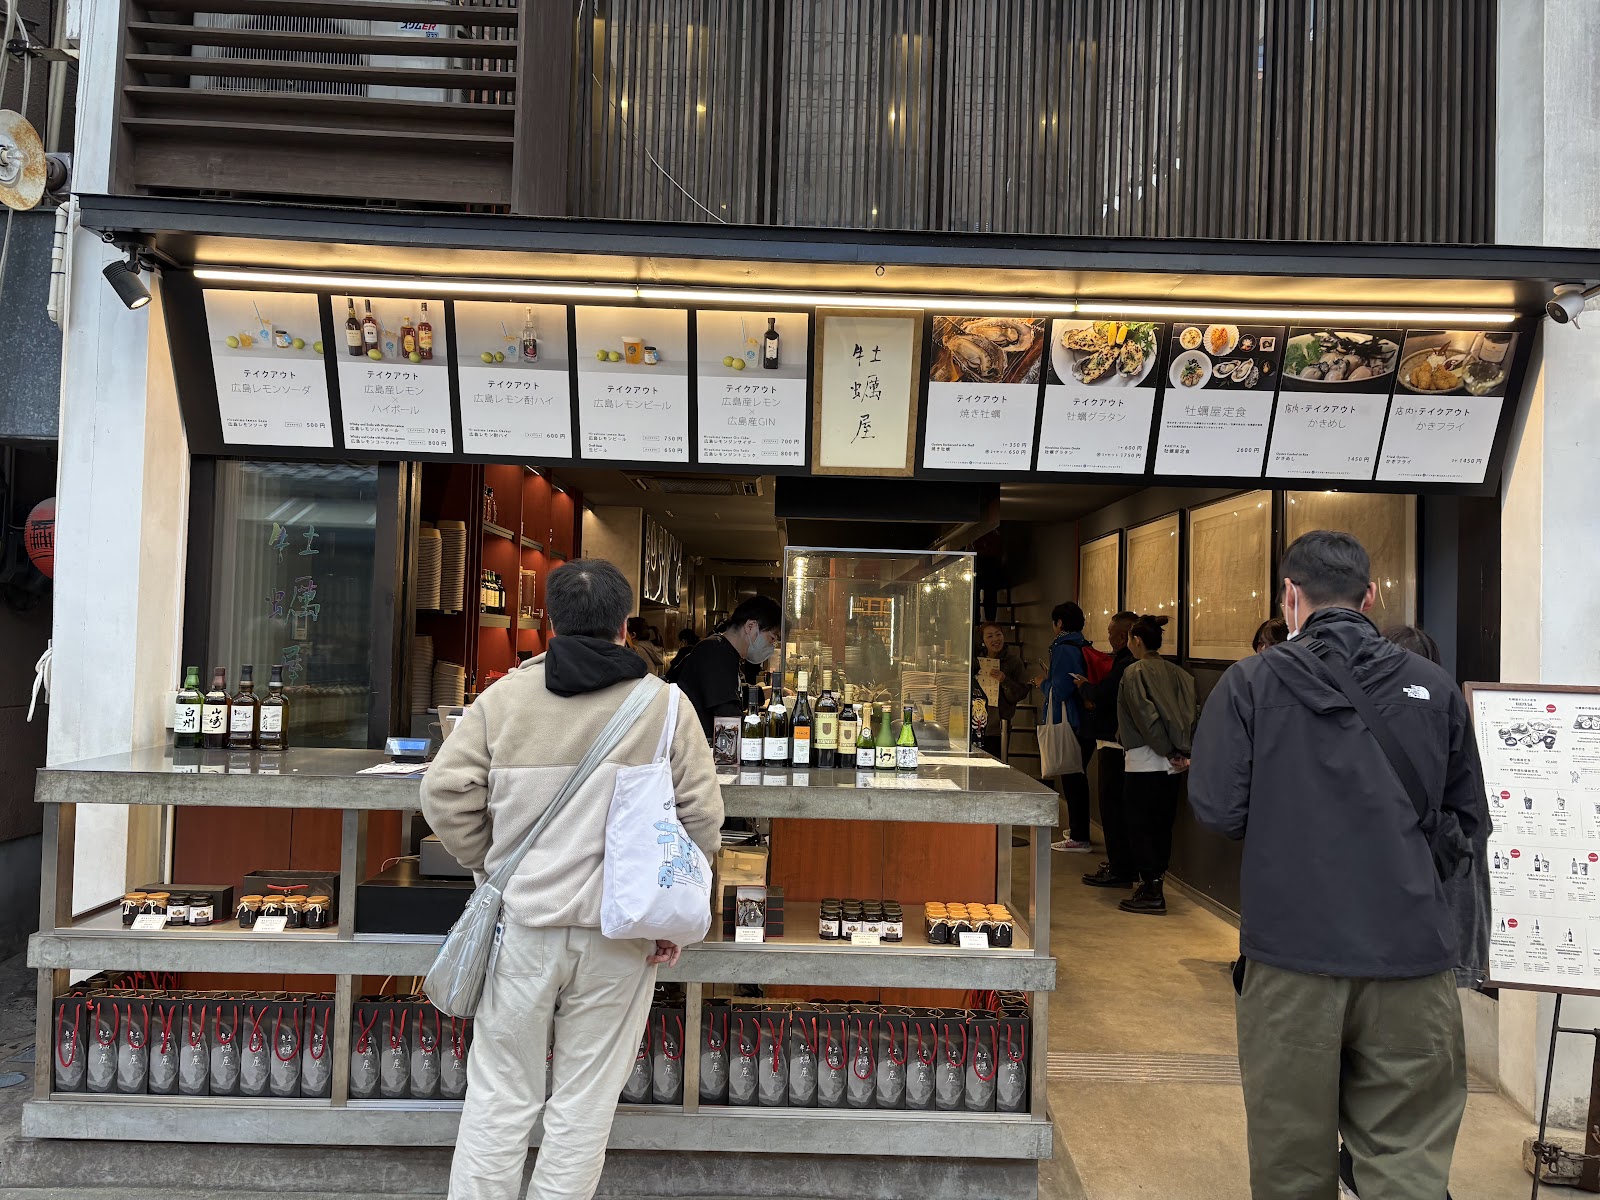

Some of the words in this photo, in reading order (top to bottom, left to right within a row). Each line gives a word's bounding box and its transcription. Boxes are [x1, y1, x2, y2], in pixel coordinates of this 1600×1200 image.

[244, 370, 296, 379] テイクアウト
[368, 370, 418, 380] テイクアウト
[232, 383, 311, 395] 広島レモンソーダ
[364, 384, 424, 395] 広島産レモン
[488, 380, 539, 390] テイクアウト
[608, 386, 658, 394] テイクアウト
[726, 385, 776, 394] テイクアウト
[850, 344, 882, 444] 牡蠣屋
[957, 395, 1007, 403] テイクアウト
[474, 394, 554, 405] 広島レモン酎ハイ
[594, 399, 672, 410] 広島レモンビール
[722, 397, 781, 407] 広島産レモン
[1073, 398, 1123, 407] テイクアウト
[372, 405, 420, 415] ハイボール
[960, 409, 1001, 419] 焼き牡蠣
[1185, 405, 1246, 418] 牡蠣屋定食
[1285, 404, 1356, 414] 店内・テイクアウト
[1395, 406, 1470, 416] 店内・テイクアウト
[728, 416, 775, 426] 広島産GIN
[1067, 412, 1126, 421] 牡蠣グラタン
[1308, 419, 1346, 428] かきめし
[1416, 422, 1464, 432] かきフライ
[183, 707, 195, 729] 白州
[210, 708, 223, 728] 山崎
